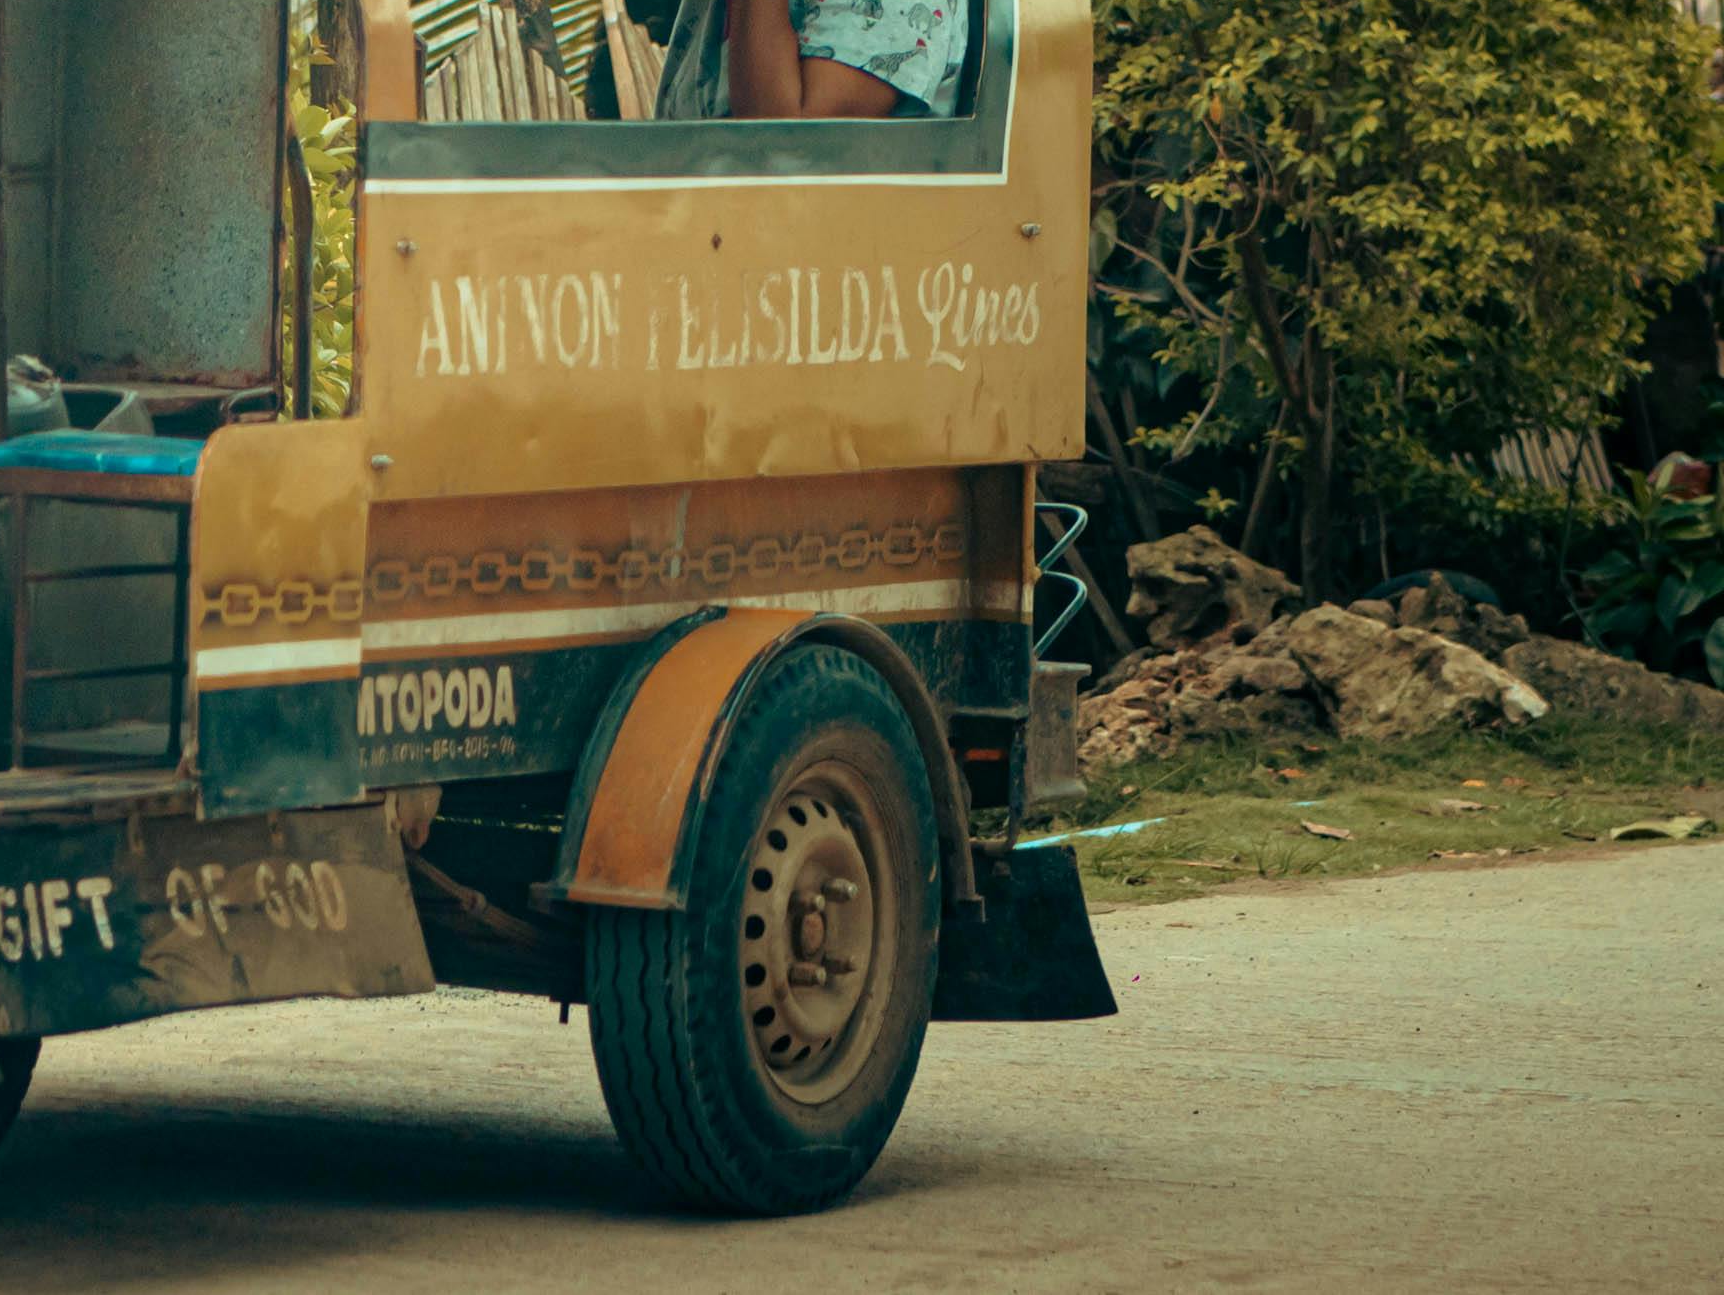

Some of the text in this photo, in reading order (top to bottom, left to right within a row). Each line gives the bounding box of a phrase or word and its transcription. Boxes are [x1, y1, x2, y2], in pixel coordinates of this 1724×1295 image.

[917, 262, 1040, 372] Lines
[165, 863, 229, 939] OF
[255, 860, 348, 932] GOD
